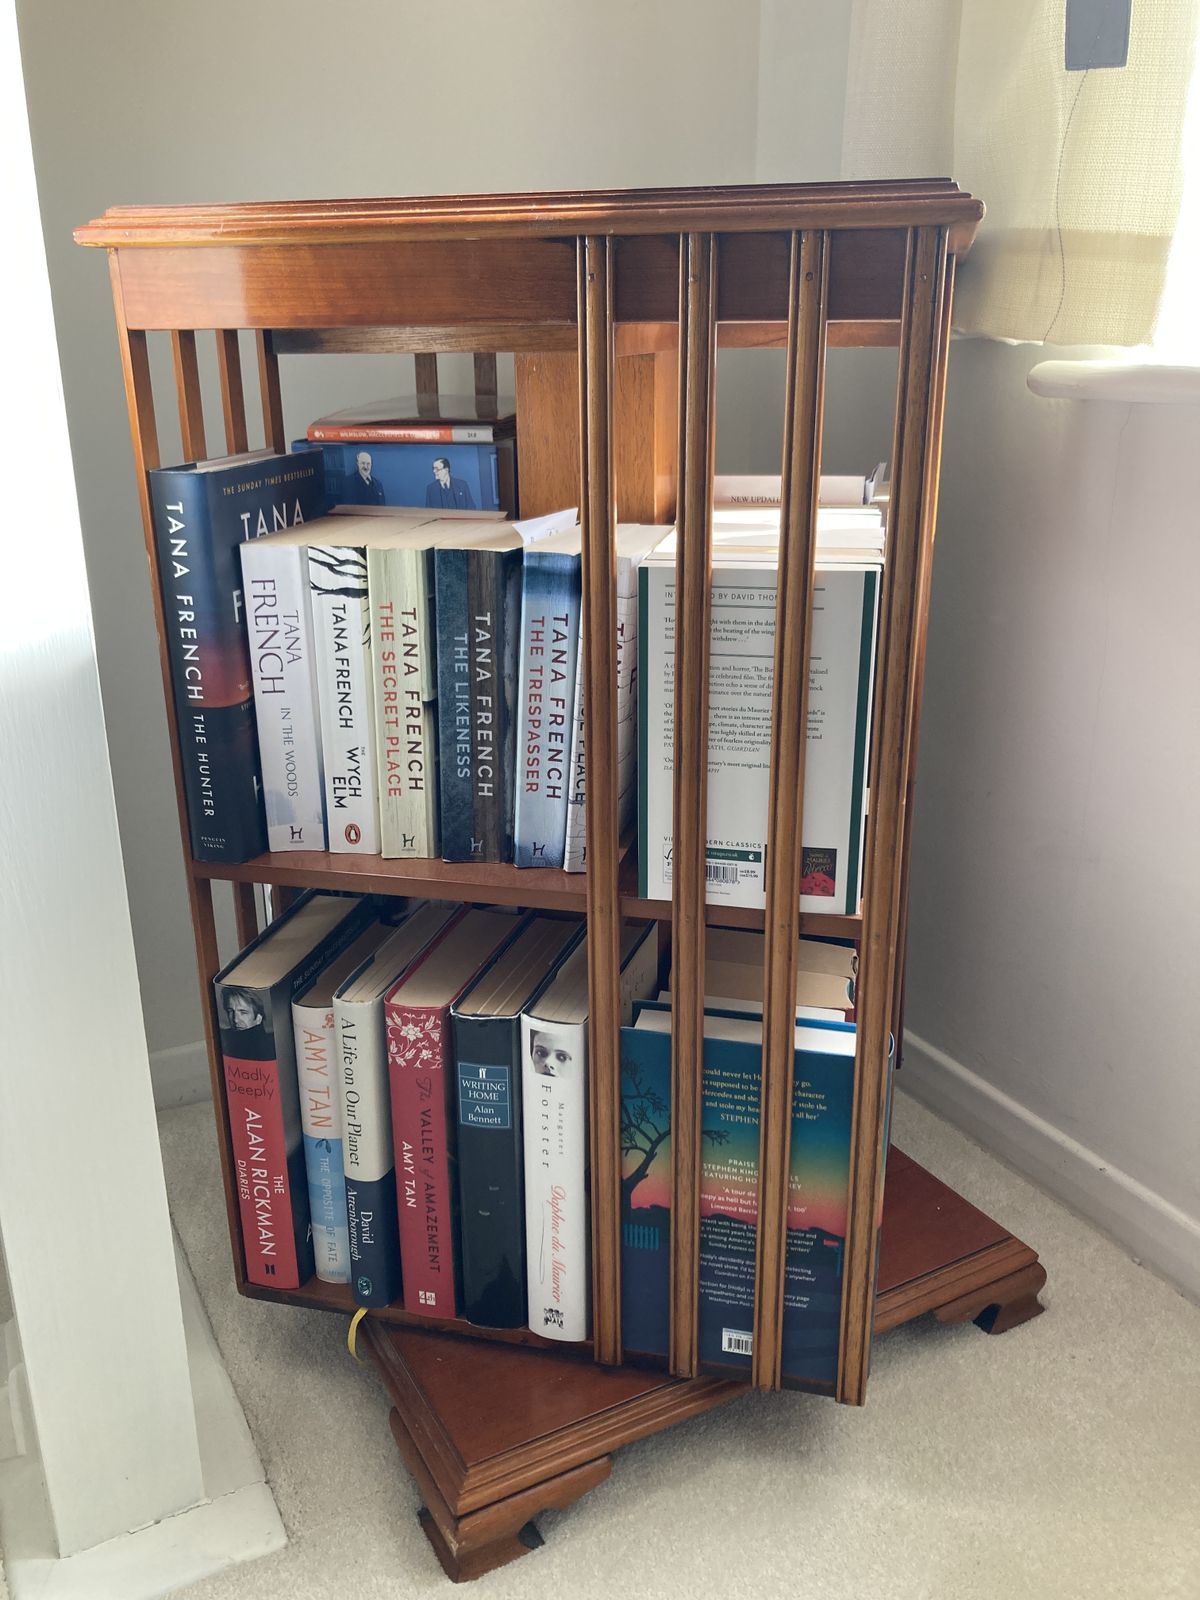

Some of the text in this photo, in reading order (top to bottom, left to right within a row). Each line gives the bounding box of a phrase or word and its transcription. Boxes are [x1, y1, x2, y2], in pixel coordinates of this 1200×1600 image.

[223, 468, 314, 496] THE SUNDAY TIMES BESTSELLER
[240, 498, 305, 541] TANA
[731, 593, 755, 601] DAVID
[251, 578, 285, 694] FRENCH
[283, 610, 302, 664] TANA
[722, 627, 743, 635] beating
[166, 501, 215, 817] TANA FRENCH THE HUNTER
[331, 603, 354, 729] TANA FRENCH
[378, 601, 402, 797] THE SECRET PLACE
[401, 607, 424, 791] TANA FRENCH
[453, 632, 470, 778] THE LIKENESS
[475, 611, 493, 797] TANA FRENCH
[525, 615, 544, 794] THE TRESPASSER
[546, 613, 569, 799] TANA FRENCH
[280, 707, 299, 797] IN THE WOODS
[346, 746, 362, 797] WYCH
[333, 776, 348, 809] ELM
[726, 840, 762, 849] CLASSICS
[303, 1029, 333, 1129] AMY TAN
[461, 1079, 506, 1091] WRITING
[722, 1071, 741, 1079] never
[227, 1080, 275, 1101] Deeply
[341, 1017, 362, 1167] A Life on Our Planet
[468, 1089, 499, 1101] HOME
[709, 1080, 740, 1089] supposed
[749, 1083, 759, 1091] be
[794, 1091, 825, 1100] character
[705, 1100, 746, 1112] and stole my
[733, 1092, 759, 1102] and she
[816, 1102, 827, 1111] the
[468, 1113, 502, 1124] Bennett
[473, 1105, 495, 1114] Alan
[720, 1113, 759, 1125] STEPHEN
[796, 1111, 805, 1119] all
[420, 1108, 434, 1164] VALLEY
[541, 1084, 552, 1169] Forster
[557, 1102, 565, 1155] Margaret
[319, 1157, 332, 1176] THE
[703, 1163, 759, 1177] STEPHEN KING
[728, 1158, 756, 1168] PRAISE
[237, 1159, 250, 1200] DIARIES
[244, 1107, 277, 1256] ALAN RICKMAN
[273, 1174, 285, 1194] THE
[402, 1141, 417, 1209] AMY TAN
[704, 1171, 744, 1182] EATURING
[320, 1178, 334, 1221] OPPOSITE
[710, 1203, 737, 1211] Linwood
[726, 1196, 739, 1204] hell
[740, 1197, 752, 1205] but
[325, 1225, 336, 1238] OF
[347, 1185, 362, 1261] Attenborough
[360, 1211, 375, 1244] David
[424, 1181, 441, 1273] AMAZEMENT
[731, 1221, 747, 1230] being
[708, 1234, 755, 1245] among America's
[708, 1241, 748, 1251] Sunday Express
[328, 1242, 339, 1262] FATE
[718, 1255, 745, 1264] decidedly
[714, 1269, 739, 1278] Guardian
[705, 1288, 736, 1298] empathetic
[708, 1295, 739, 1305] Washington
